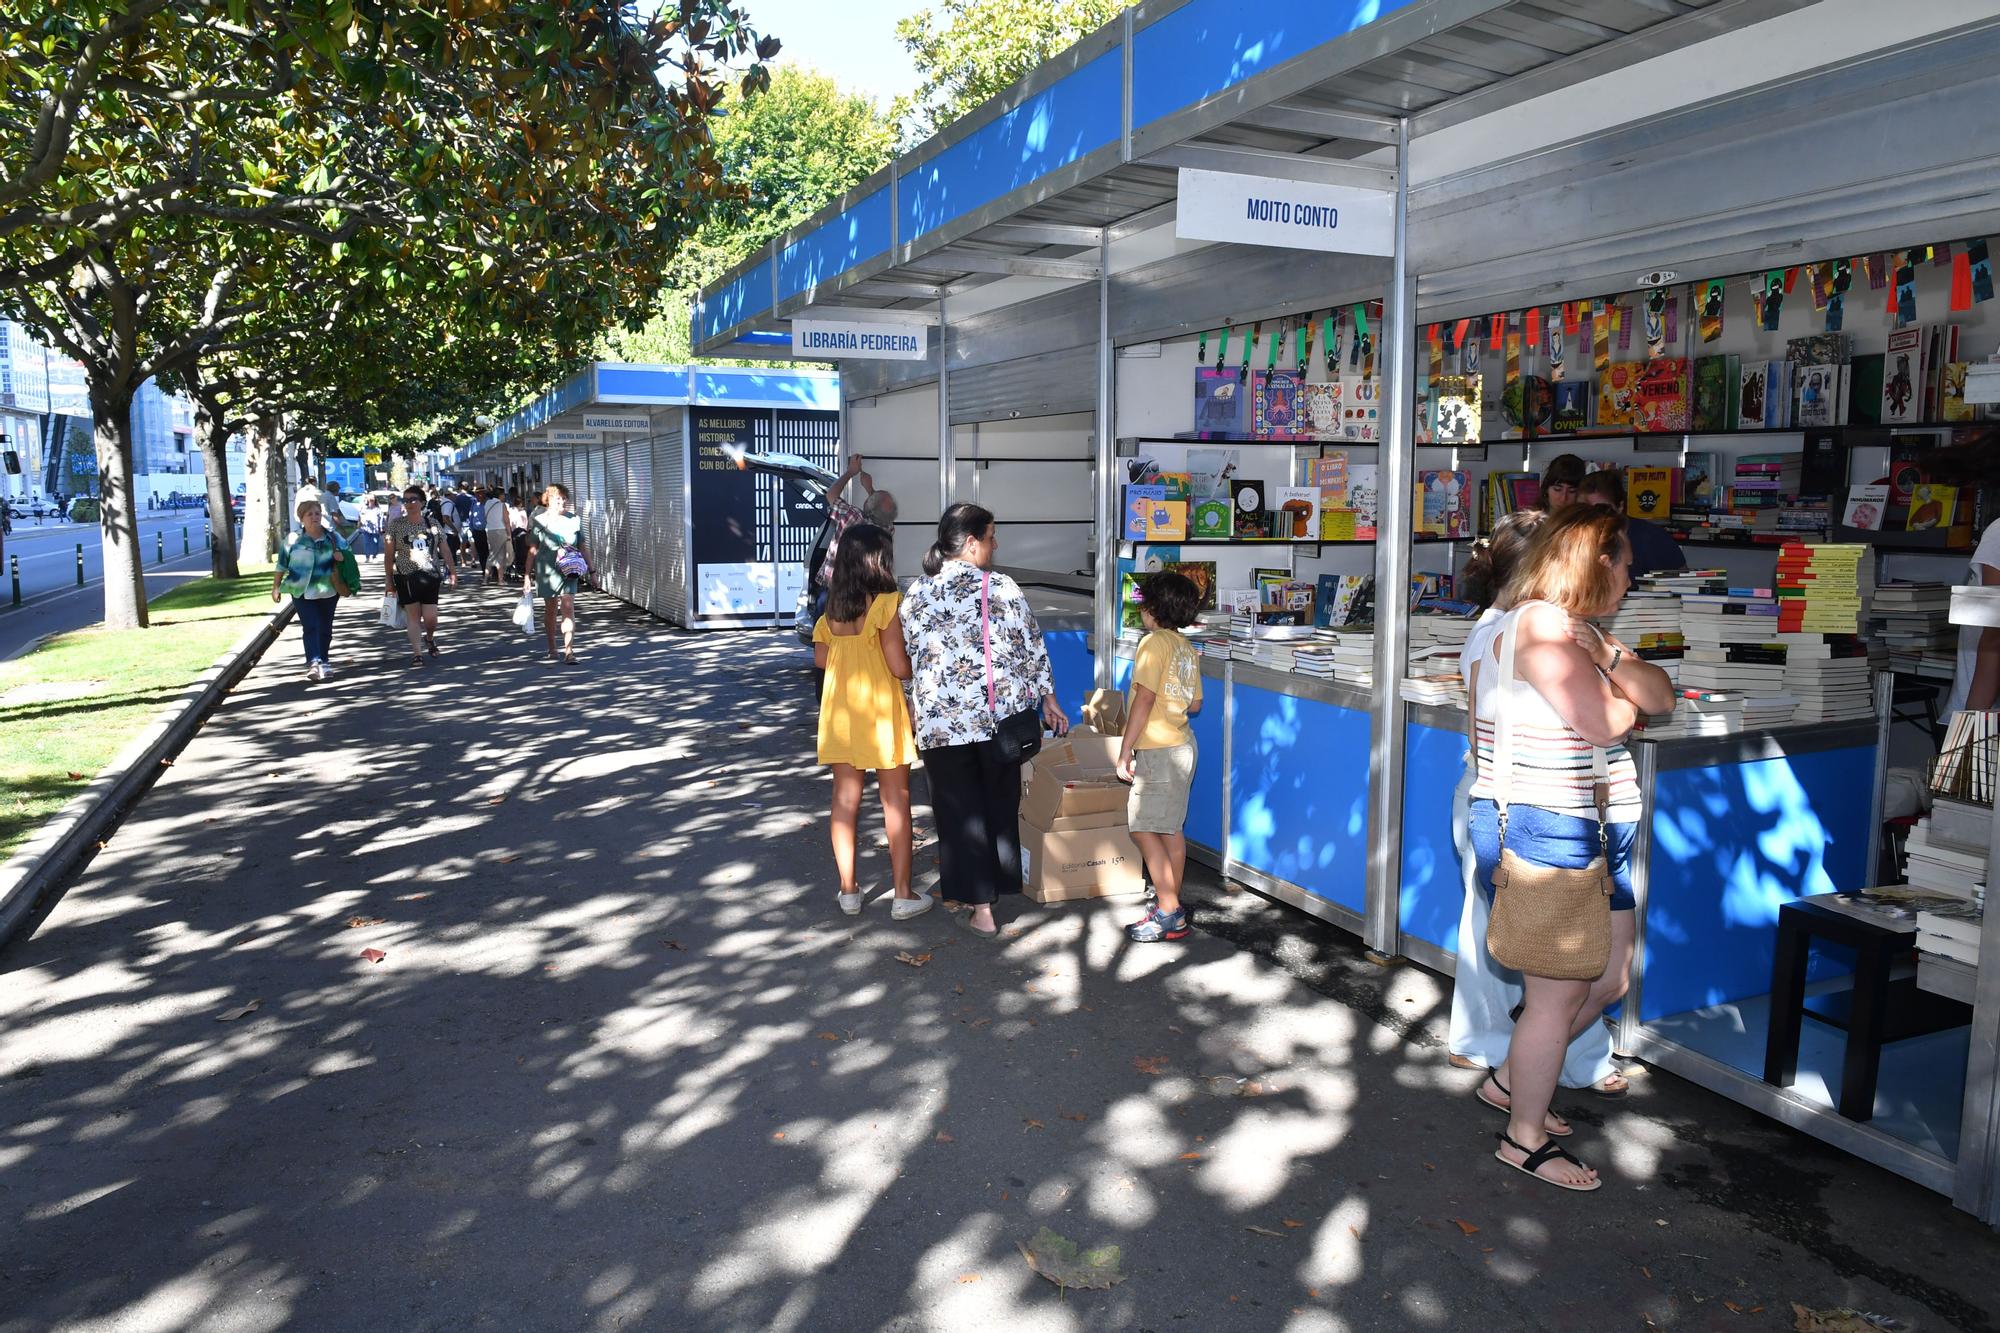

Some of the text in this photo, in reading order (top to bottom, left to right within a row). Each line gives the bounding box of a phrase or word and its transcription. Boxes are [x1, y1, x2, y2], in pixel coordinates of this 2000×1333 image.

[1247, 198, 1338, 228] MOITO CONTO
[802, 330, 918, 351] LIBRARÍA PEDREIRA
[1642, 381, 1680, 396] VENENO
[585, 419, 649, 428] ALVARELLOS EDITORA
[698, 418, 746, 429] AS MELLORES
[1554, 420, 1585, 430] OVNIS
[698, 432, 736, 443] HISTORIAS
[699, 460, 714, 470] CUN
[715, 461, 725, 470] BO
